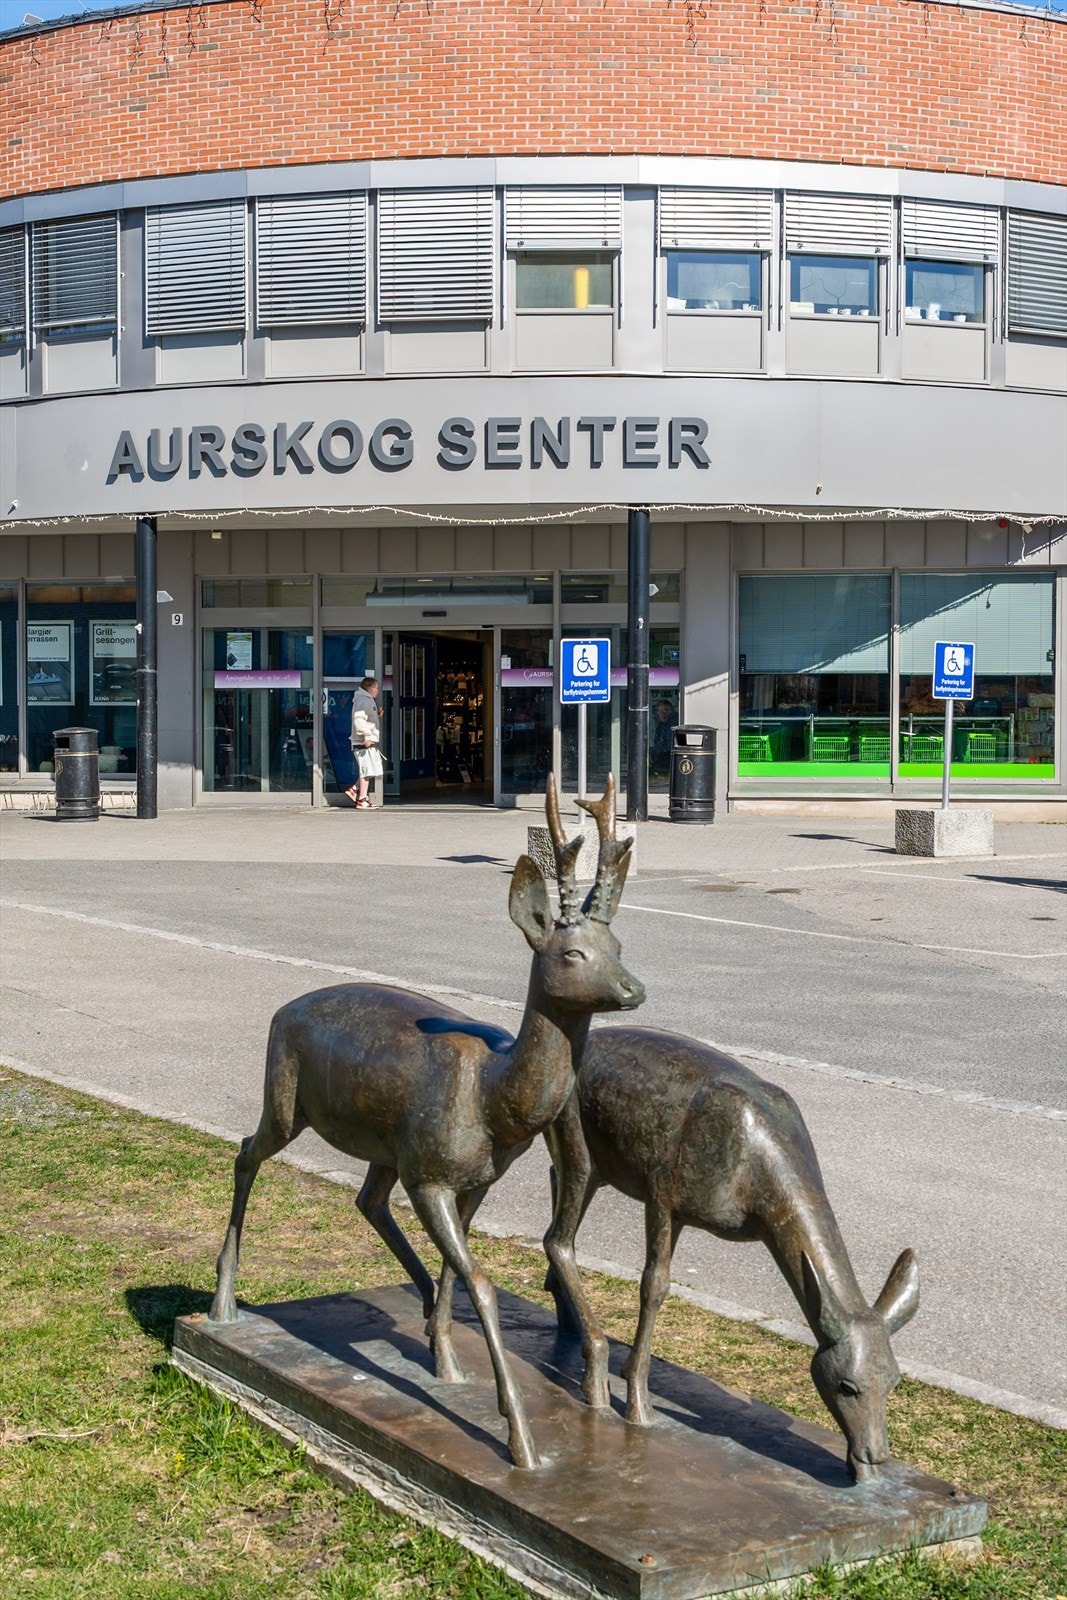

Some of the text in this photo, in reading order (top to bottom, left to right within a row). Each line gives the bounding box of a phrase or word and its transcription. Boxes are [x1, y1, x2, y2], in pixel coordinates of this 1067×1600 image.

[105, 416, 712, 485] AURSKOG SENTER
[174, 614, 181, 624] 9
[28, 628, 52, 636] largjør
[95, 628, 117, 636] Grill-
[95, 637, 135, 645] sesongen
[570, 680, 593, 688] Parkering
